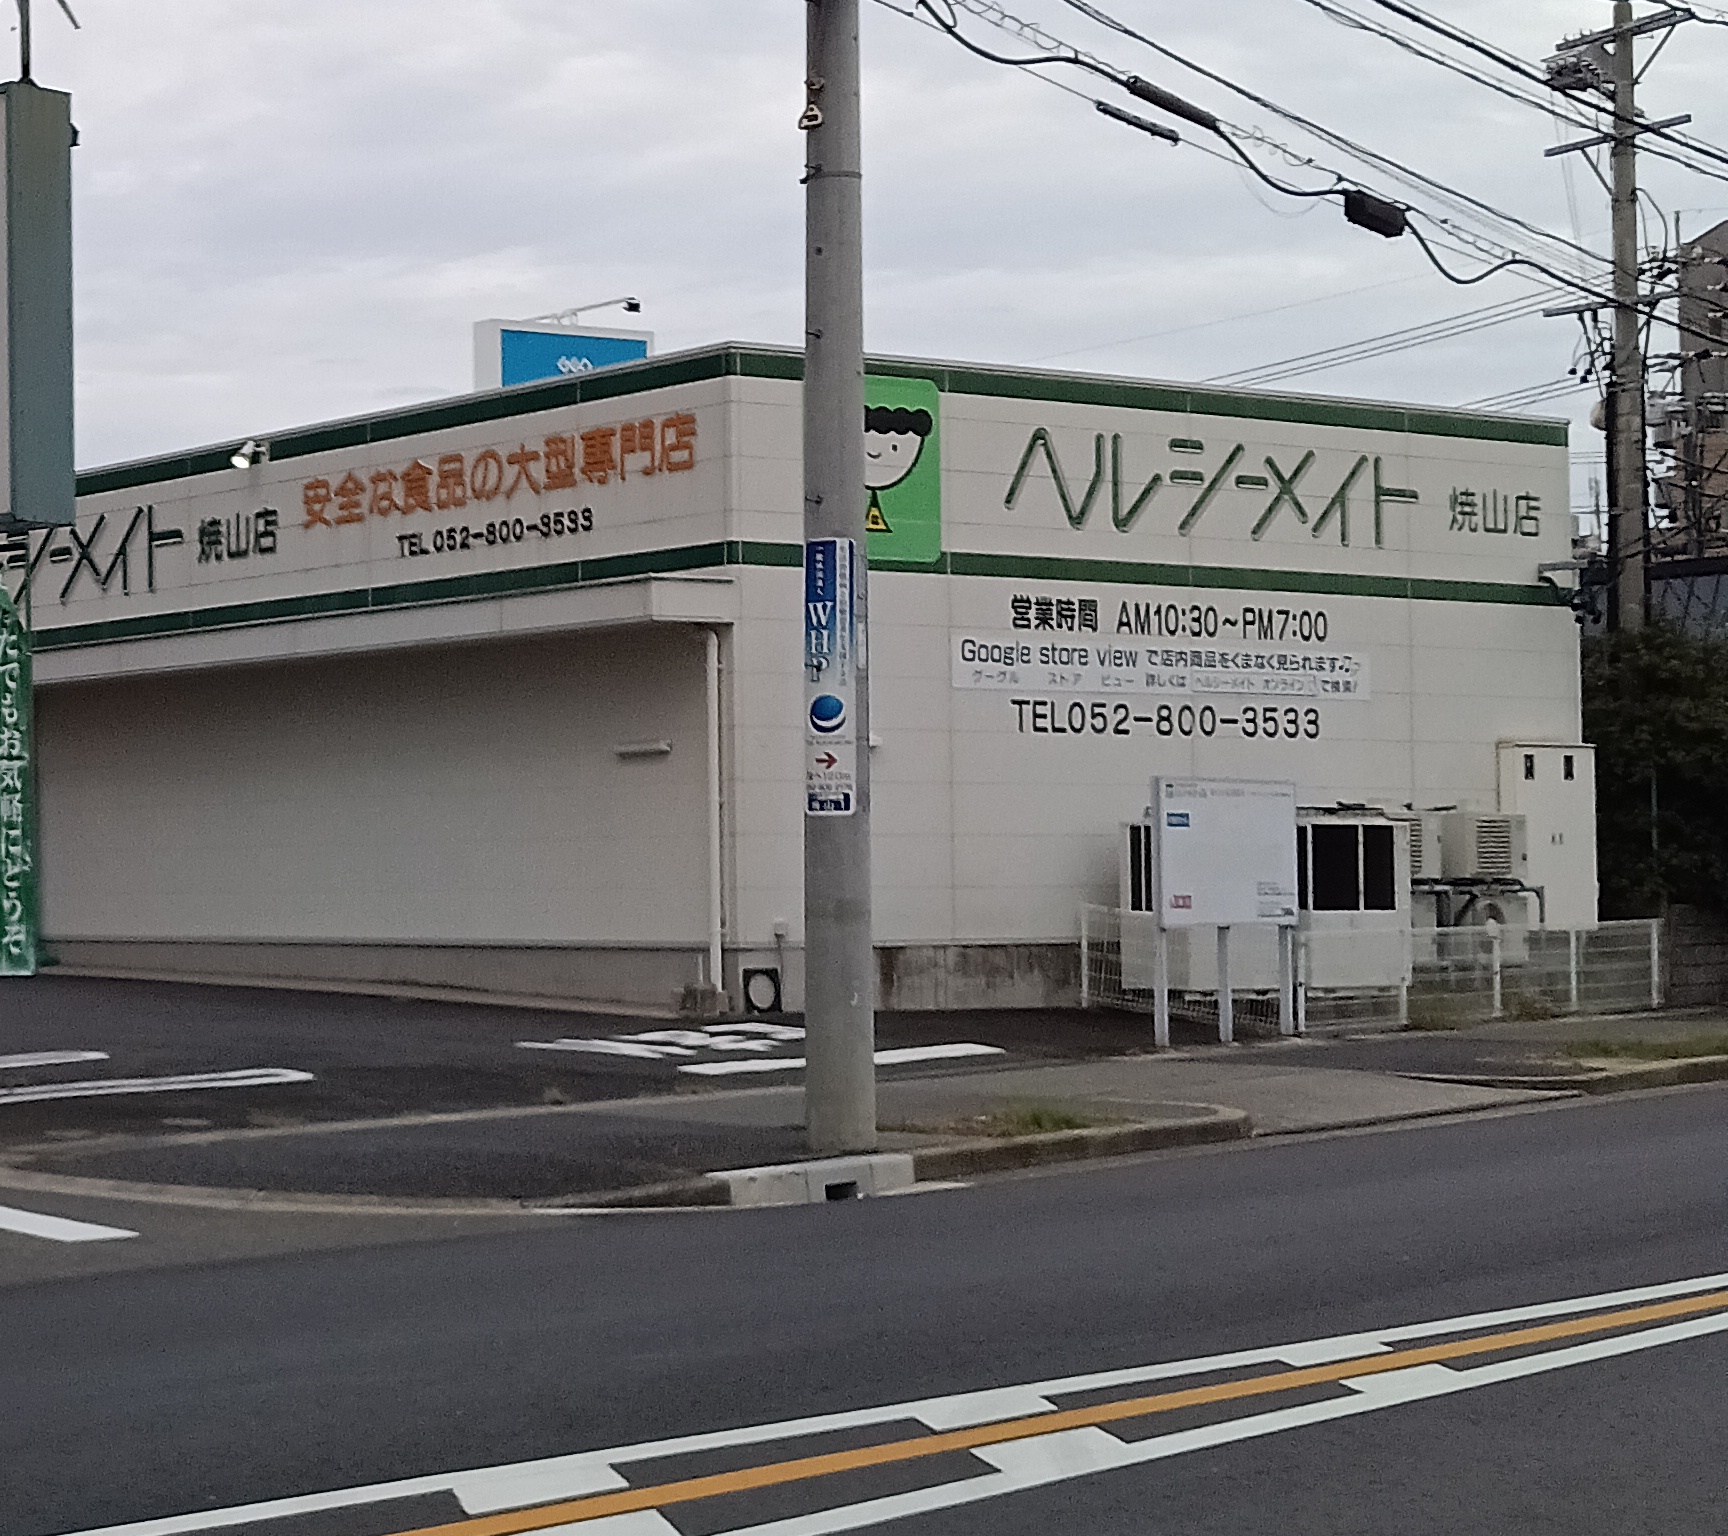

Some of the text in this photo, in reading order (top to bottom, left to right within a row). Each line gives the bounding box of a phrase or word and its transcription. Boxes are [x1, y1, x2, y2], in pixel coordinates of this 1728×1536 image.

[303, 412, 697, 529] 安全な食品の大型専門店
[1003, 426, 1542, 548] ヘルシーメイト 焼山店
[197, 507, 279, 564] 焼山店
[1010, 594, 1099, 633] 営業時間
[961, 638, 1031, 666] Google
[1039, 642, 1089, 666] store
[1096, 644, 1138, 668] view
